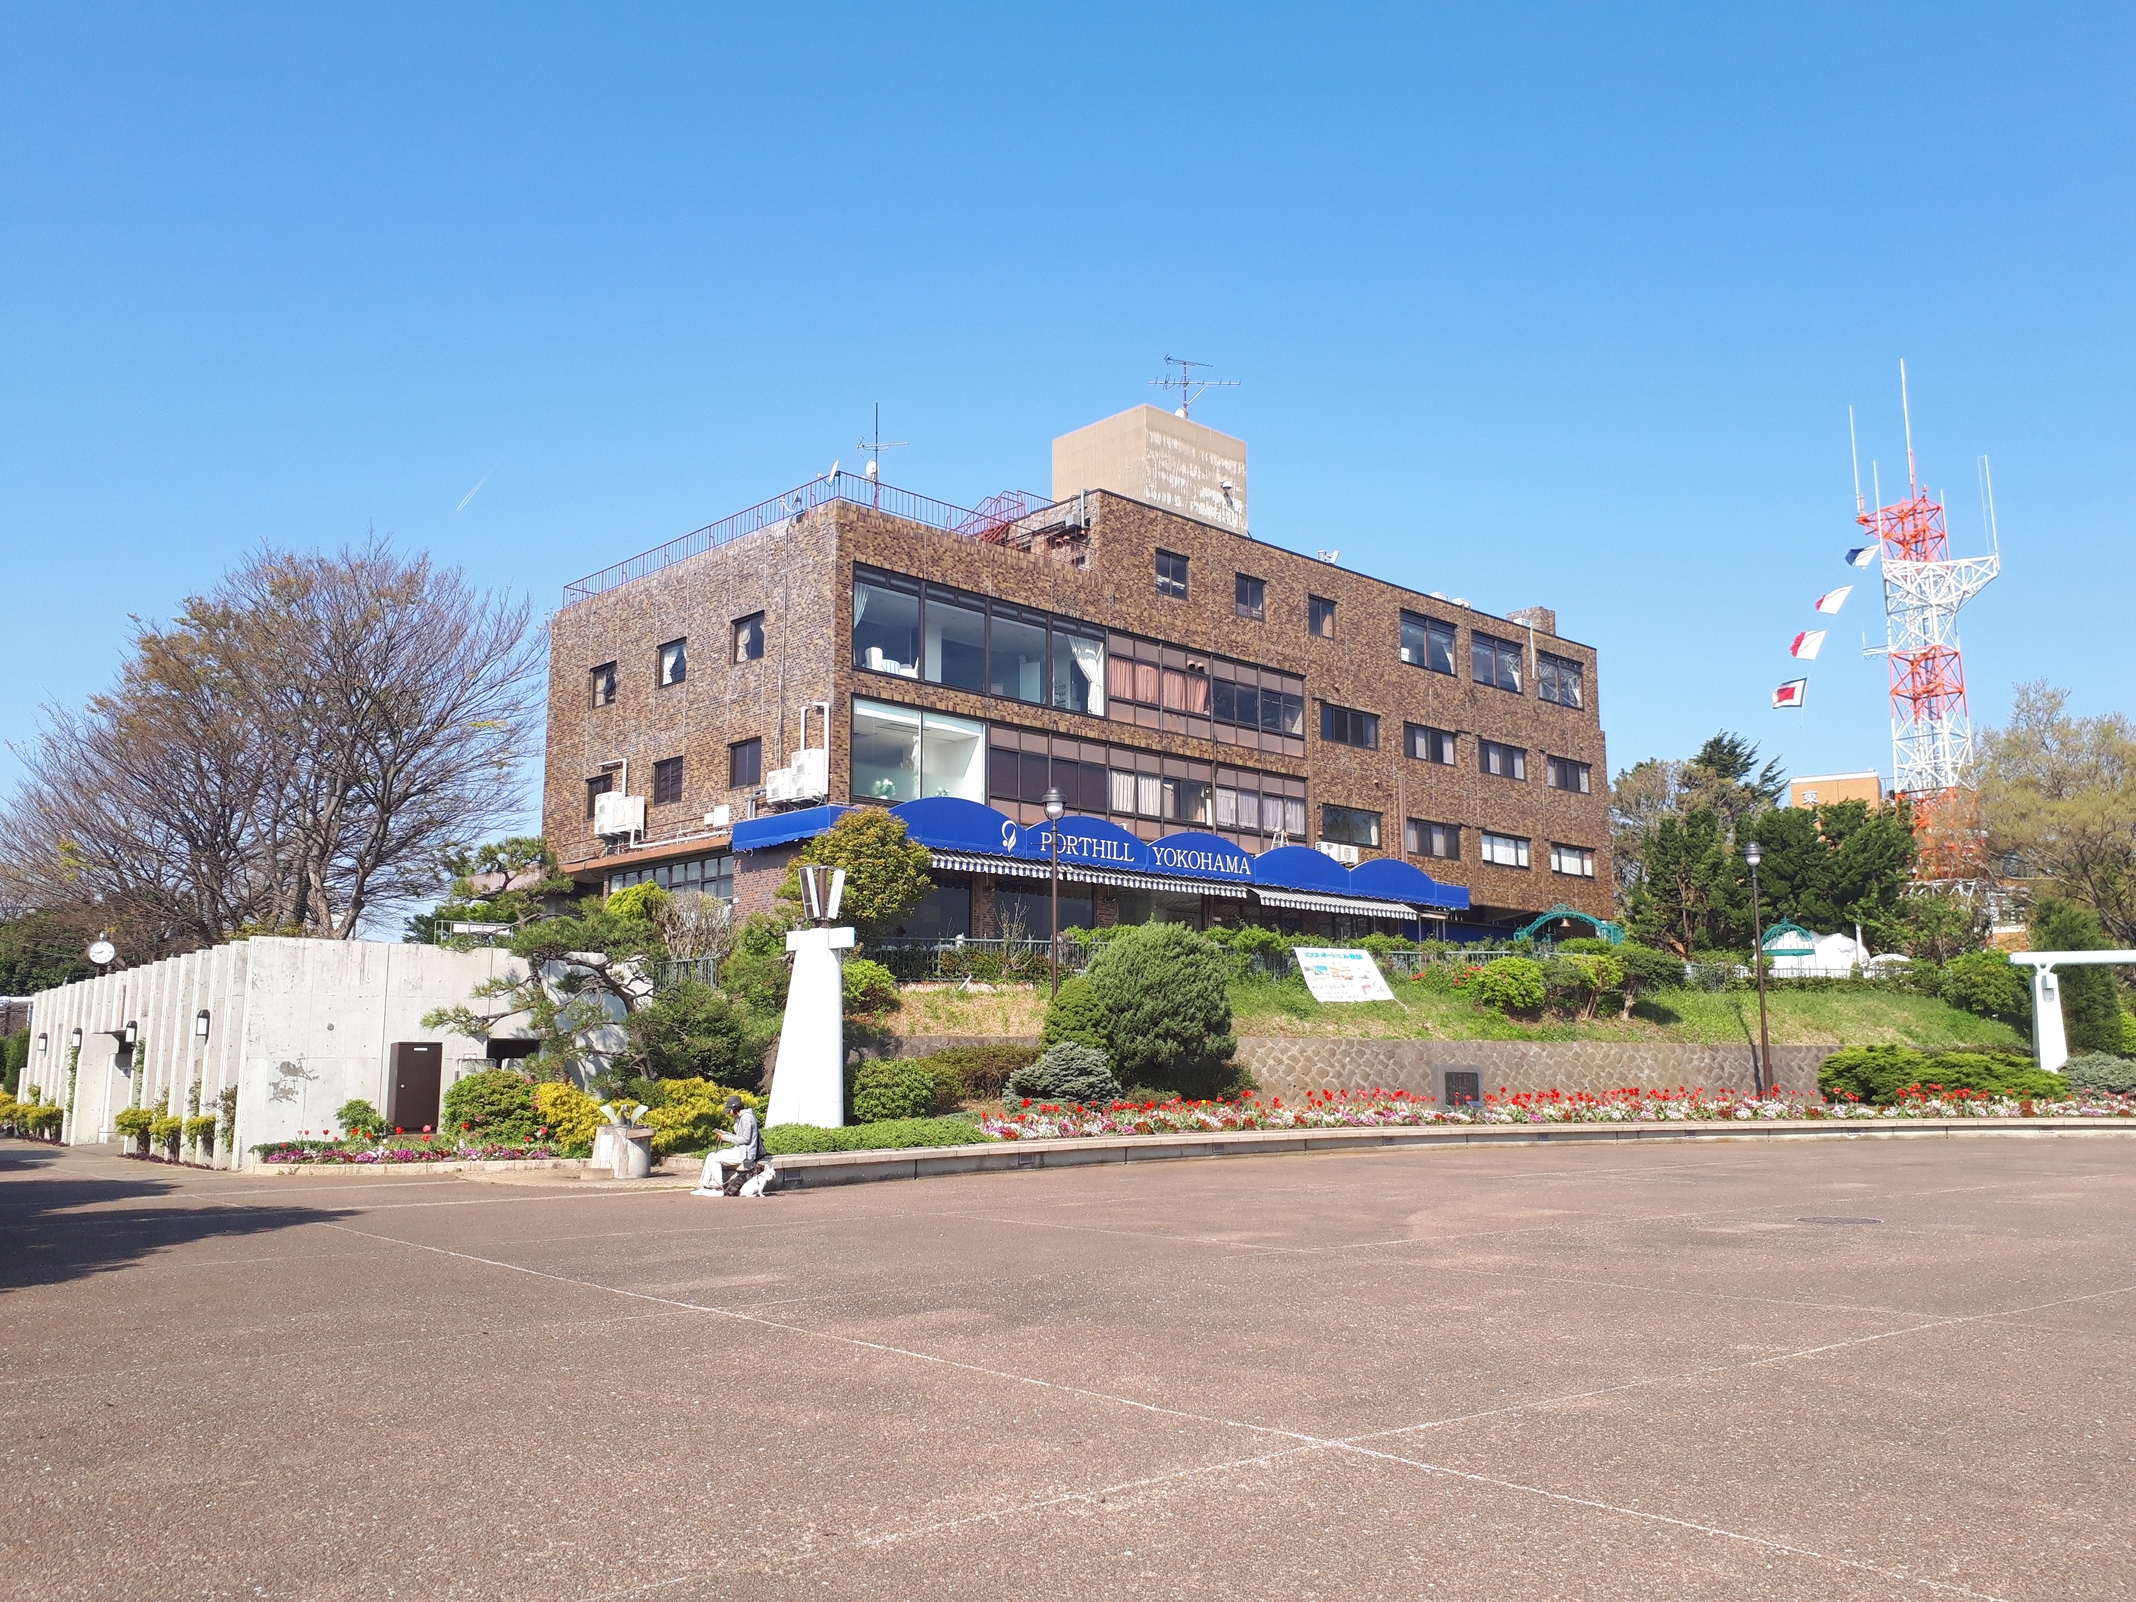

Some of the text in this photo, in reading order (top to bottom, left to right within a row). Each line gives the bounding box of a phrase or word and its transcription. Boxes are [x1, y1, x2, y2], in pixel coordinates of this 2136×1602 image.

[1802, 790, 1819, 805] 東
[1041, 832, 1251, 875] PORTHILL YOKOHAMA
